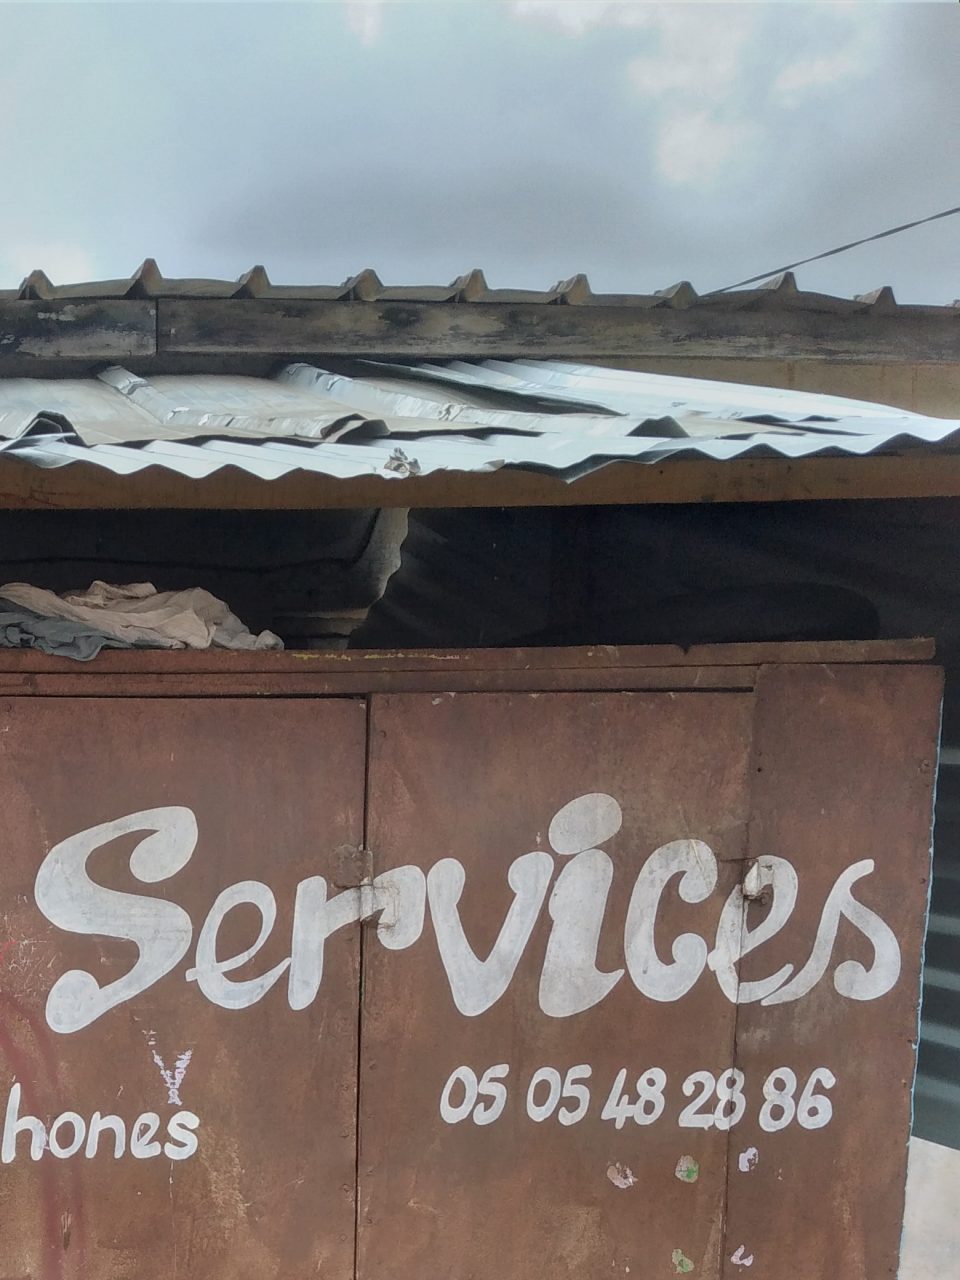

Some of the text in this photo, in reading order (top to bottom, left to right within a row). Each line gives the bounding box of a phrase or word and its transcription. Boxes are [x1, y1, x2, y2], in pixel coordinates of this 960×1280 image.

[34, 792, 902, 1034] Services
[439, 1063, 837, 1132] 05 05 48 28 86
